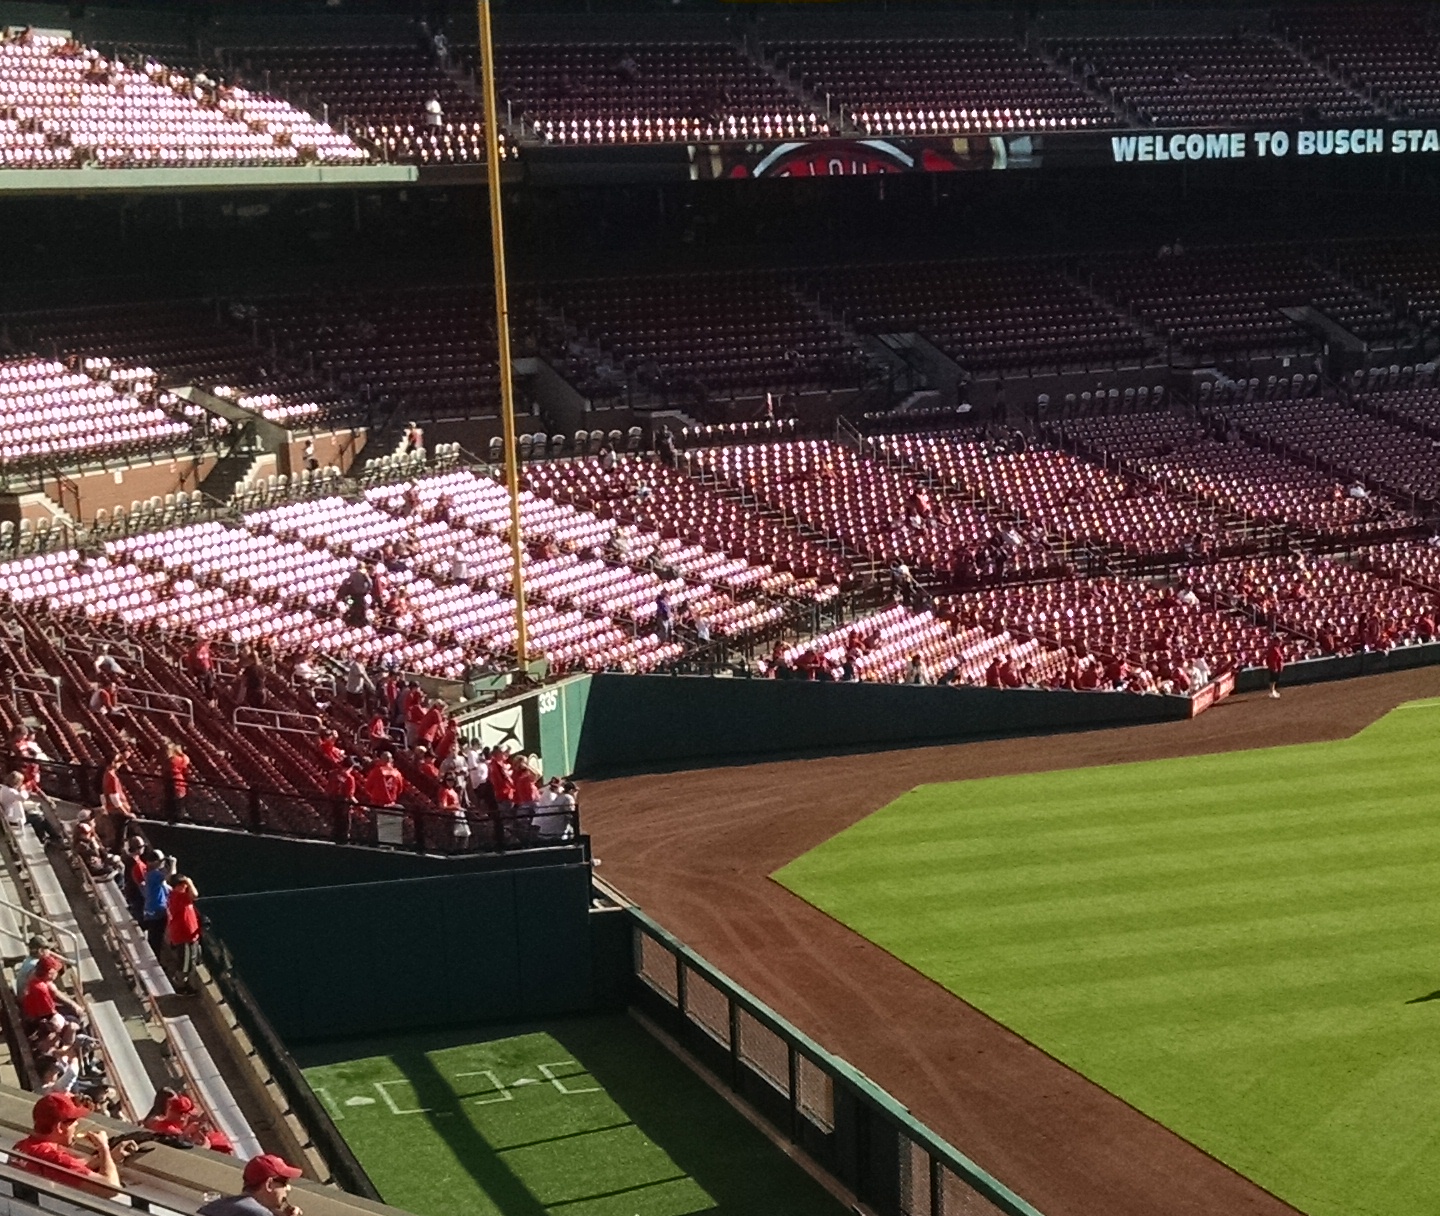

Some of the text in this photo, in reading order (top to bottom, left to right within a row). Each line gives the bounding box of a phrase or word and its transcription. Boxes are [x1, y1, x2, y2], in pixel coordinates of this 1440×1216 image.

[1111, 133, 1247, 162] WELCOME
[1255, 131, 1289, 157] TO
[1297, 129, 1384, 156] BUSCH
[539, 689, 558, 714] 335
